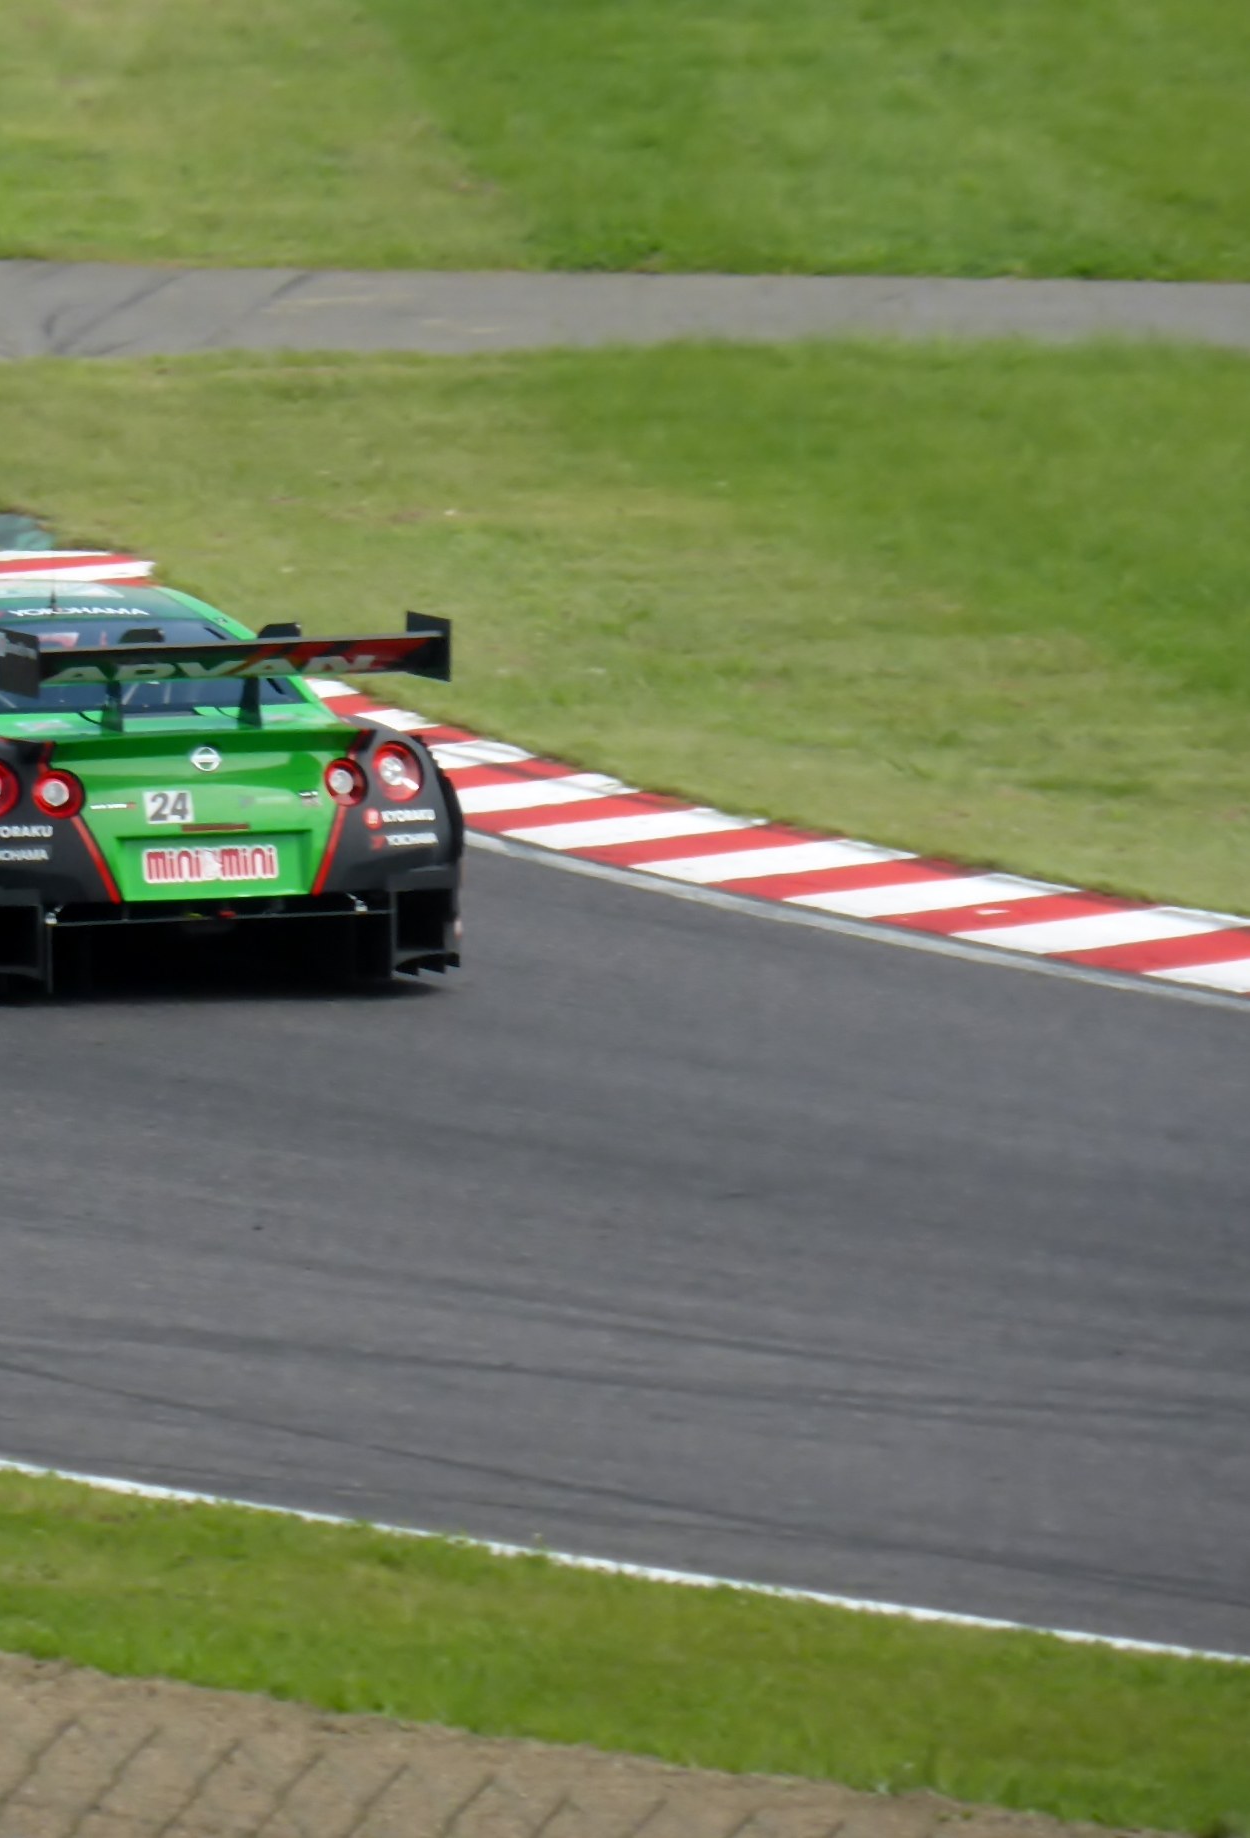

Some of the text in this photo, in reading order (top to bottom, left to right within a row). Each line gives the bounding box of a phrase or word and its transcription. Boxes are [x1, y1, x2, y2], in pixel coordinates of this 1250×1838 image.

[8, 606, 149, 617] YOKOHAMA
[41, 654, 383, 684] ADVAN
[149, 792, 189, 822] 24
[381, 808, 436, 823] KYORAKU
[146, 847, 275, 881] mini mini
